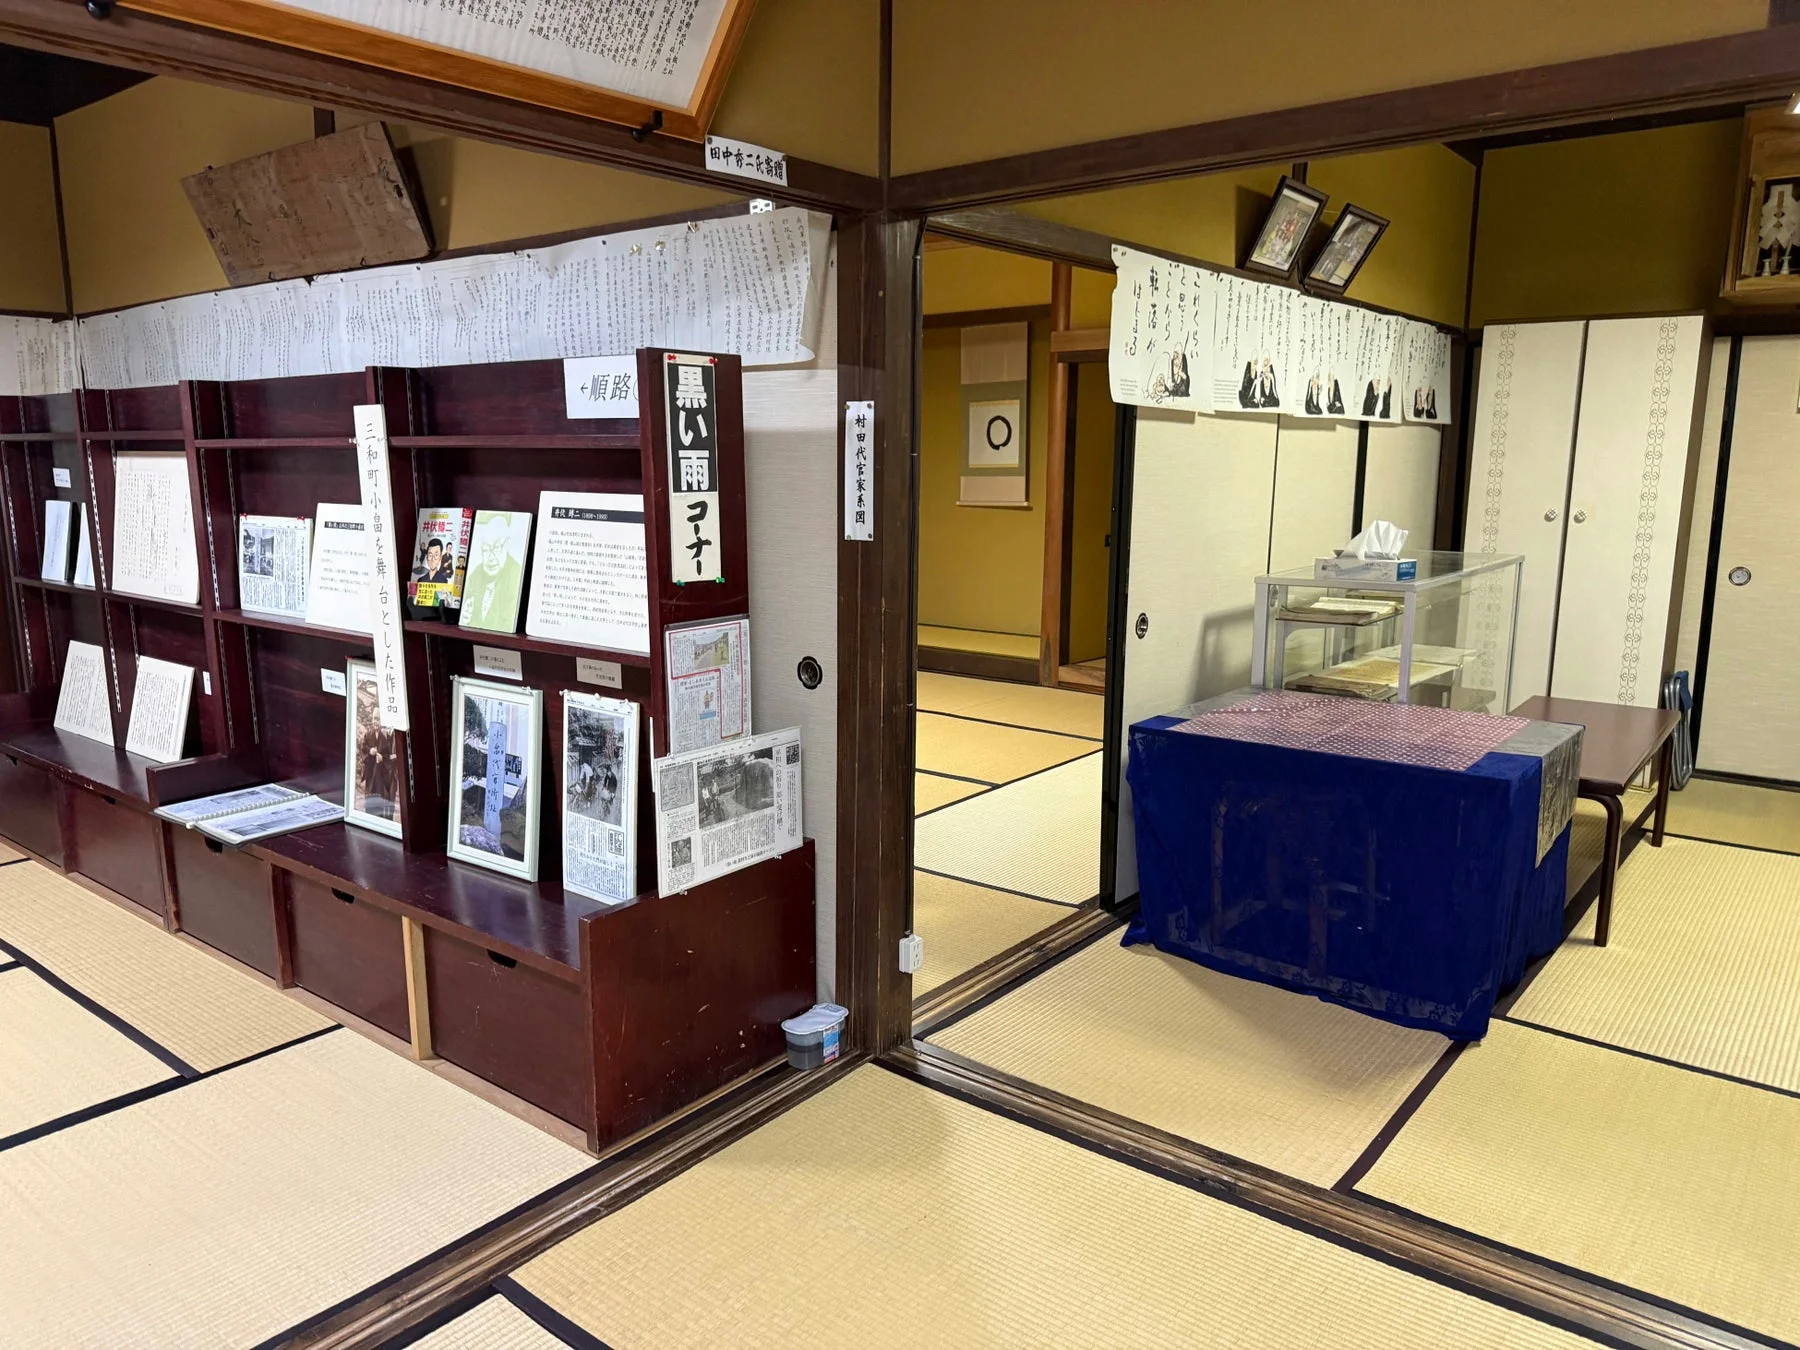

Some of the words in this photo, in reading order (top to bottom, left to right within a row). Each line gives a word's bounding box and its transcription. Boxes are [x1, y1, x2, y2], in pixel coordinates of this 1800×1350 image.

[855, 414, 867, 525] 村田代官家系図
